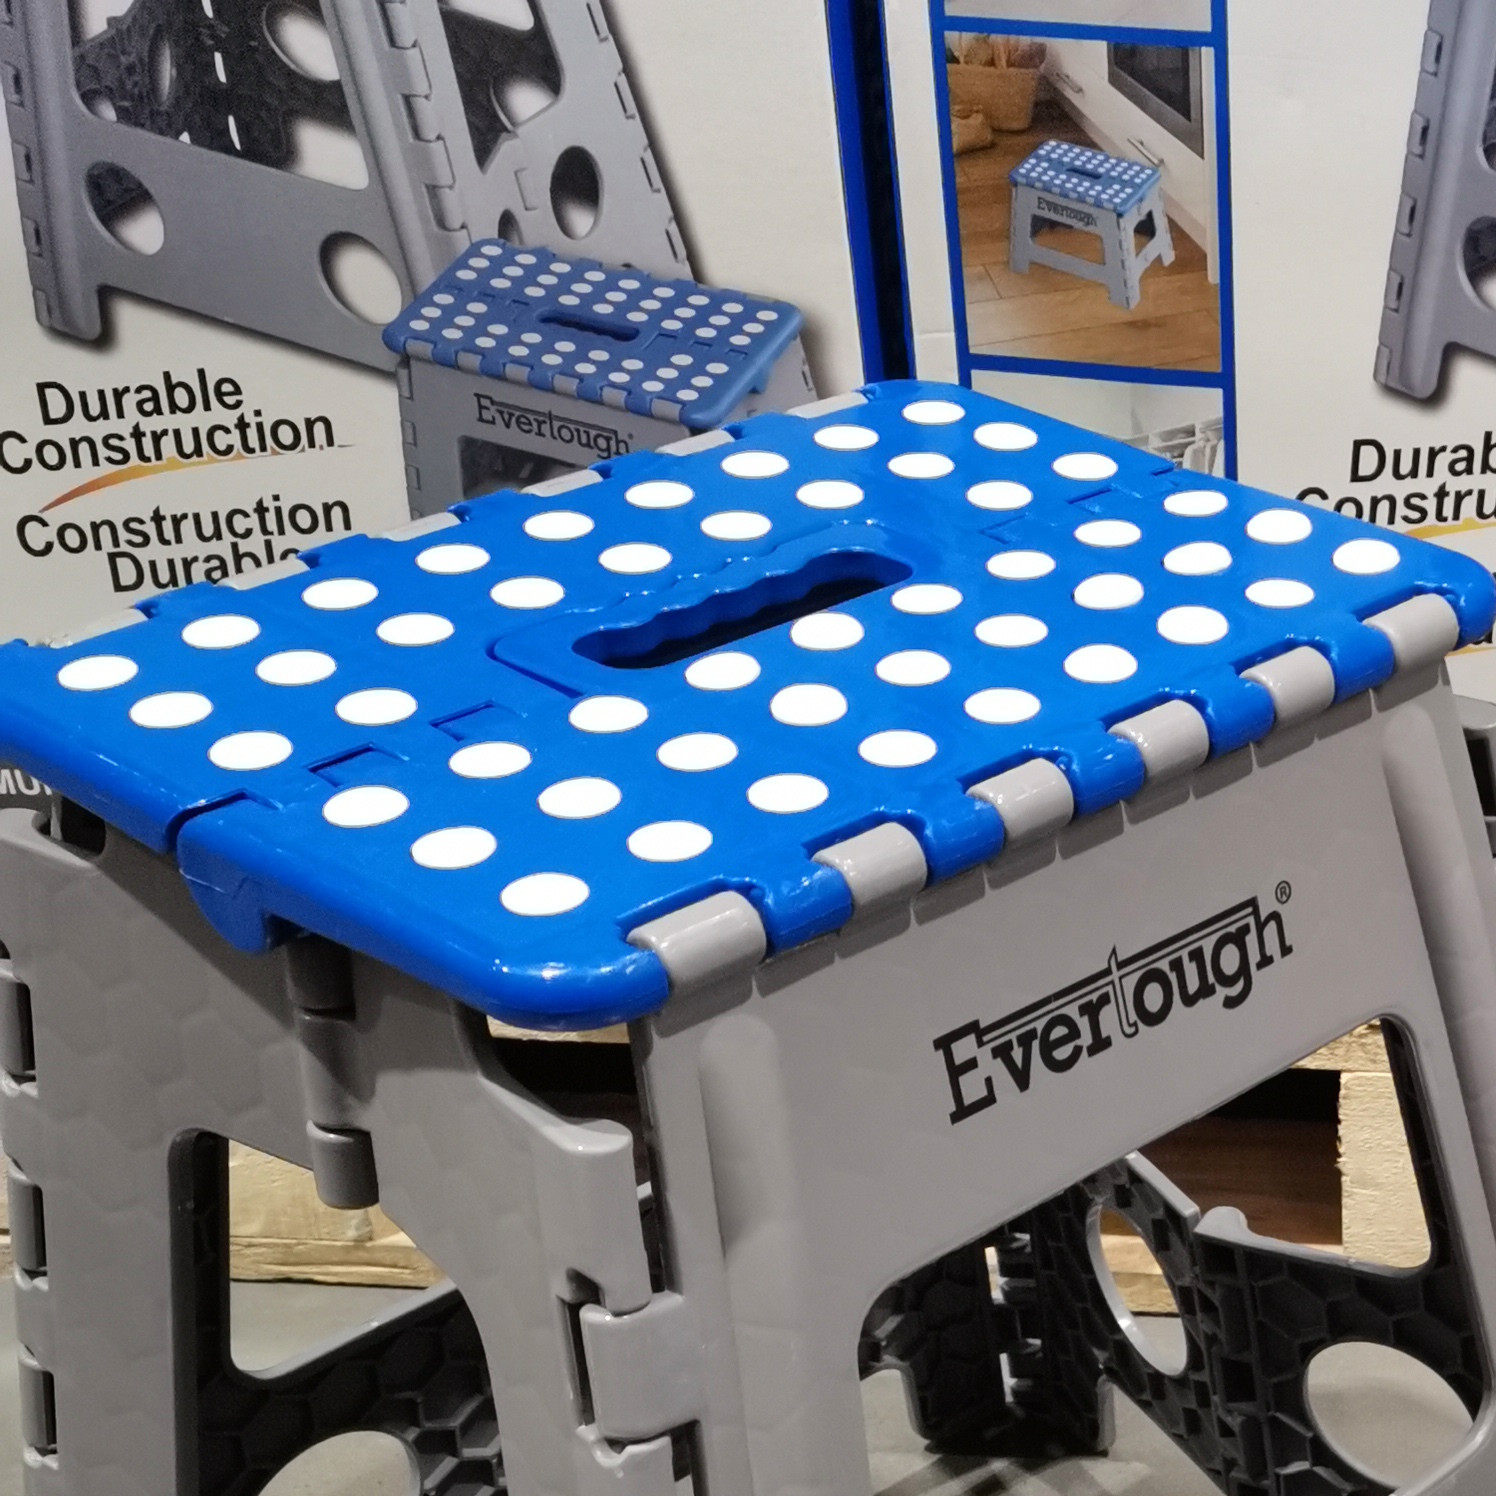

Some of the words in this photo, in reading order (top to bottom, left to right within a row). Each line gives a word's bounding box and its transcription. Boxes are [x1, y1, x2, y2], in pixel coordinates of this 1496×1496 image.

[36, 368, 243, 426] Durable
[0, 409, 336, 475] Construction
[16, 494, 352, 557] Construction
